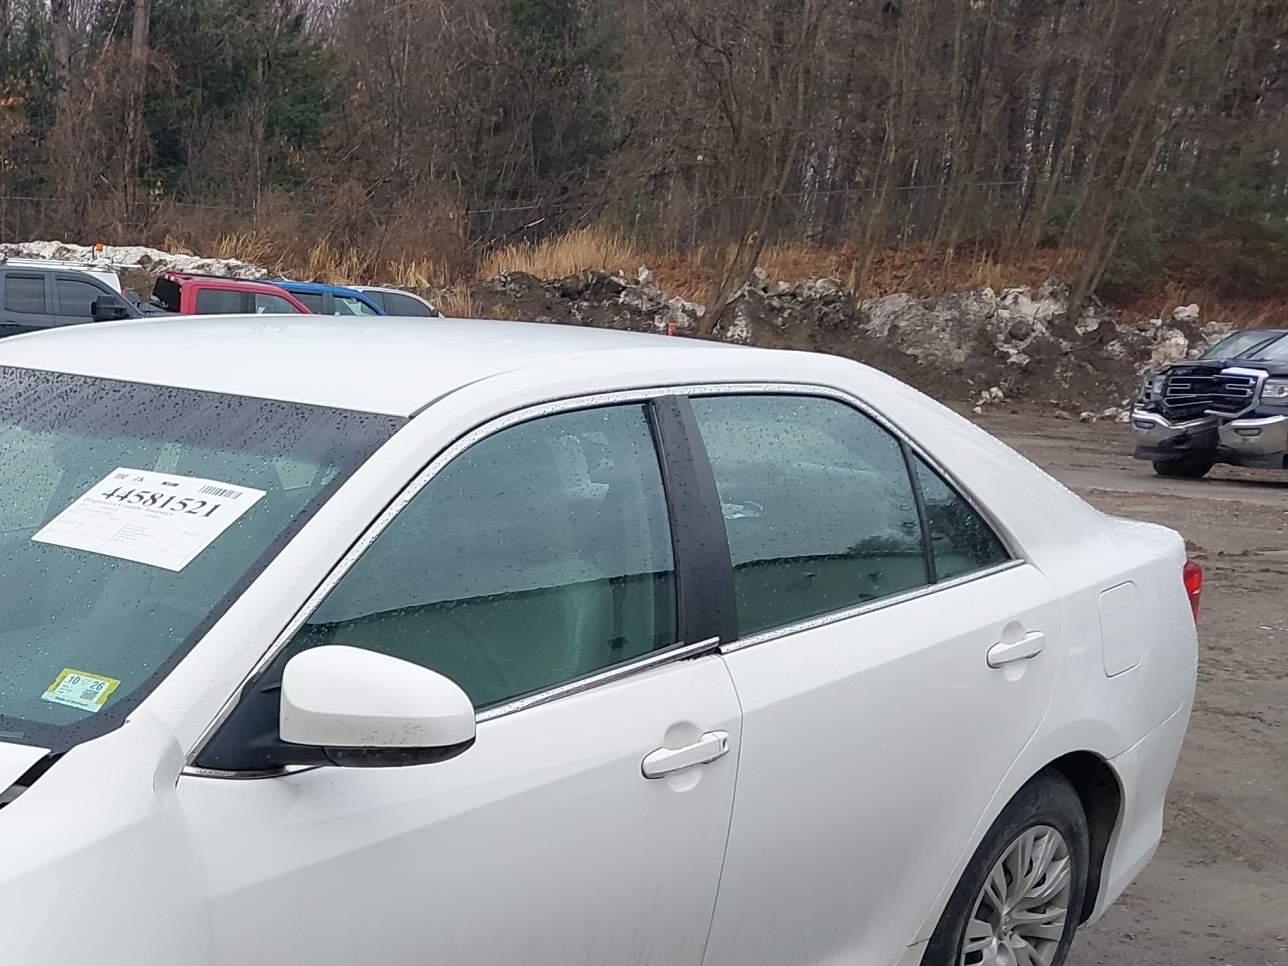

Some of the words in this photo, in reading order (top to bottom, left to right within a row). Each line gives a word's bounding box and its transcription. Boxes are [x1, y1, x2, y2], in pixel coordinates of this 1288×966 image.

[101, 486, 221, 518] 44581521
[67, 675, 81, 685] 10
[90, 680, 105, 691] 26
